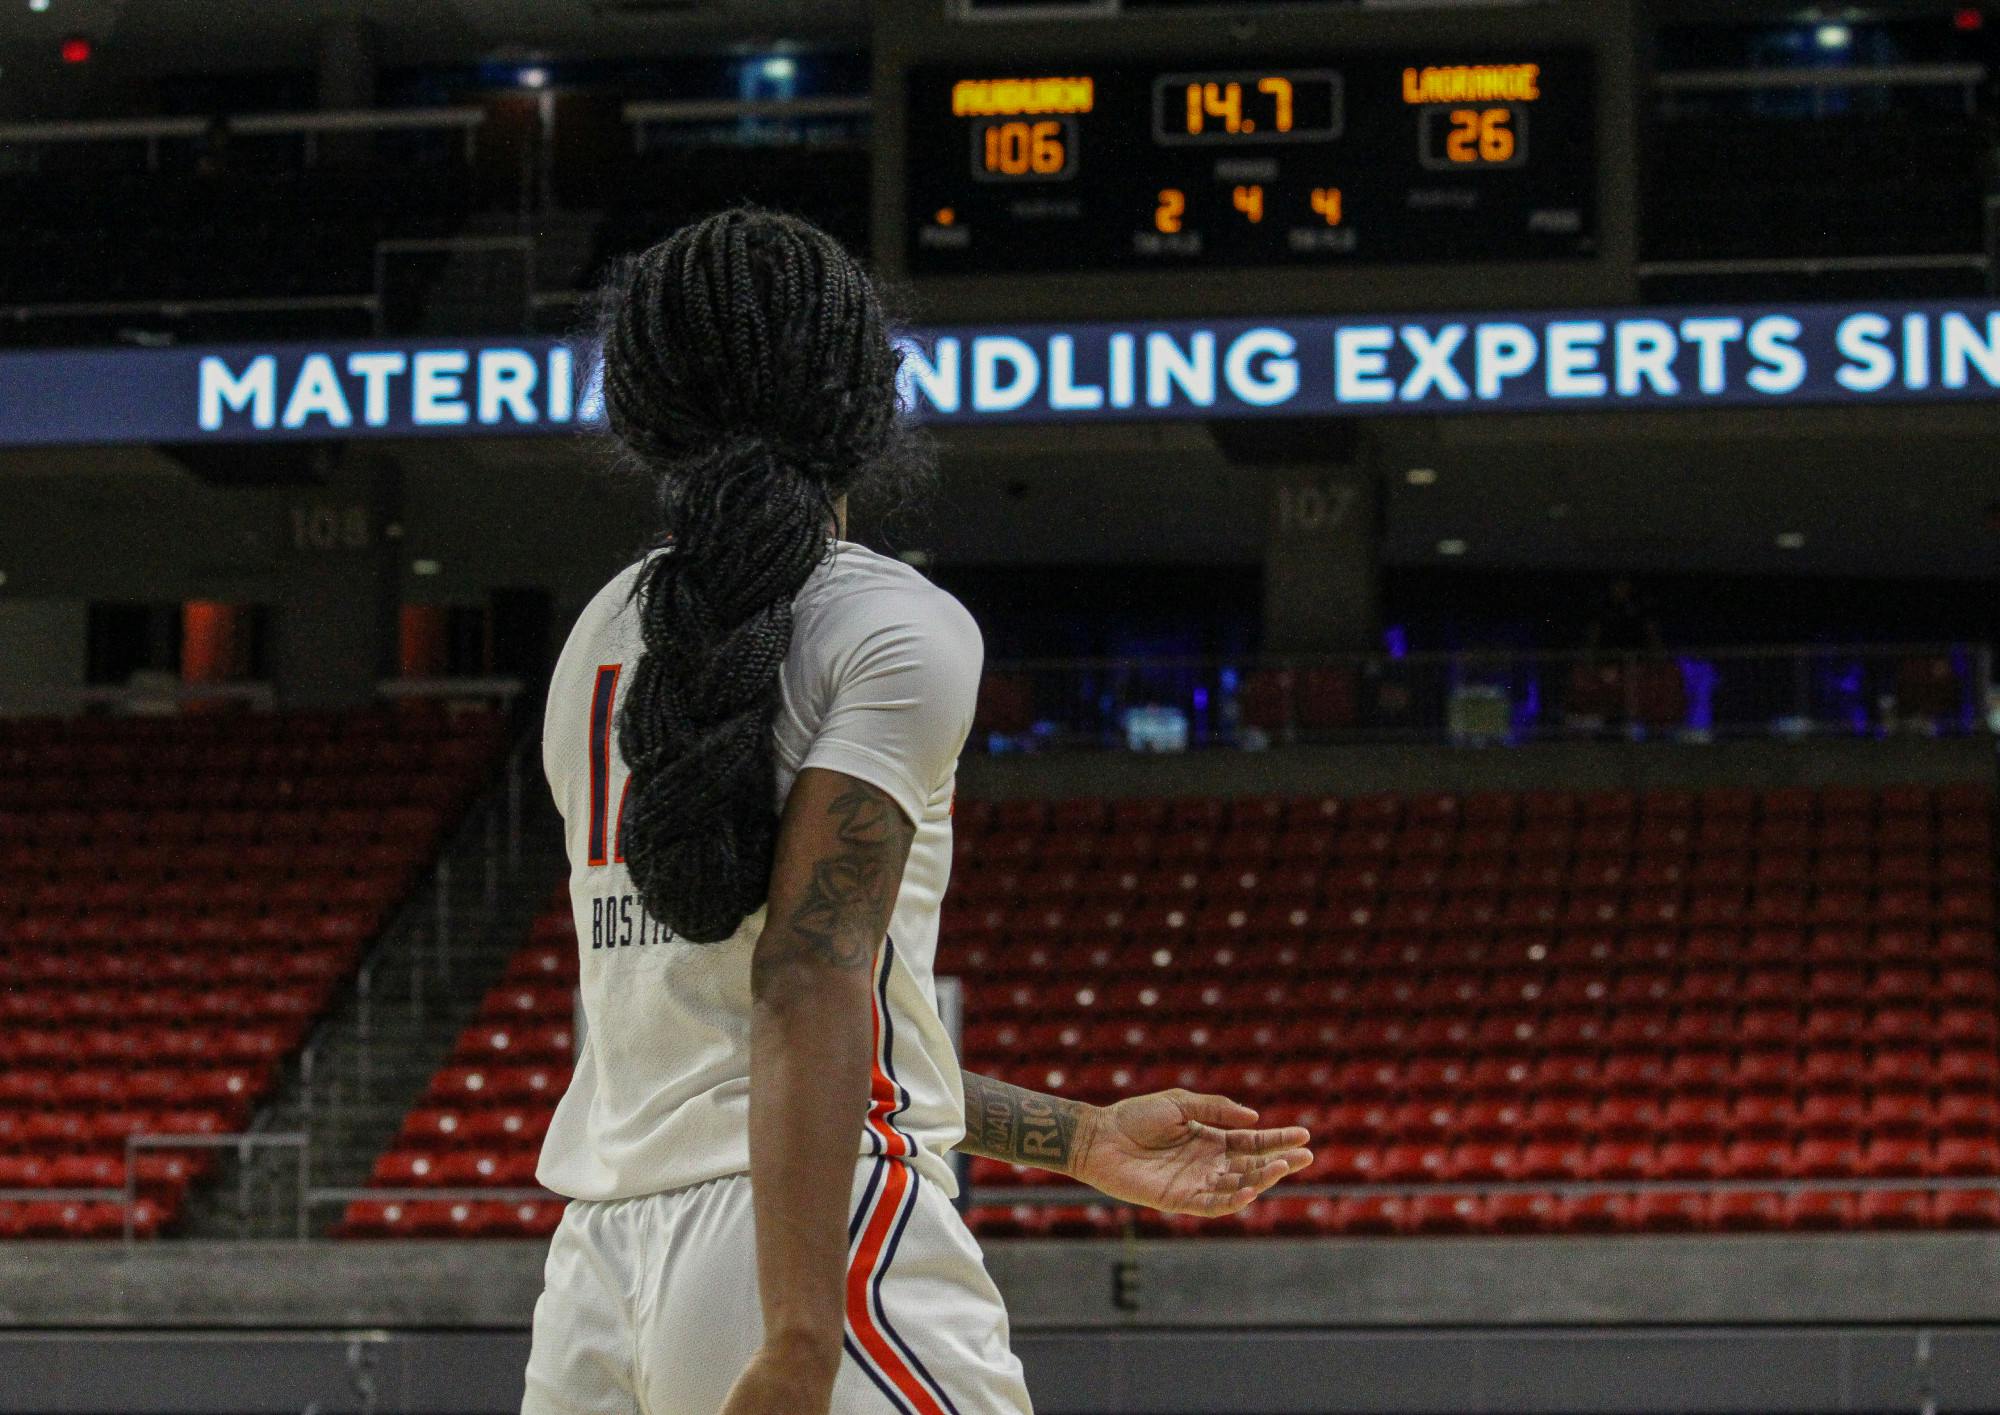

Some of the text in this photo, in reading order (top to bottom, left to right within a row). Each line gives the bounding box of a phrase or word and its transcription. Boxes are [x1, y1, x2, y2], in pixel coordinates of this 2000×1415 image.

[1187, 77, 1293, 134] 14.7
[985, 121, 1065, 175] 106
[1446, 108, 1515, 162] 26
[1155, 188, 1186, 234] 2
[1232, 185, 1263, 223] 4
[1310, 187, 1342, 226] 4
[198, 311, 2000, 431] MATERI NDLING EXPERTS SIN
[1112, 1263, 1139, 1311] E
